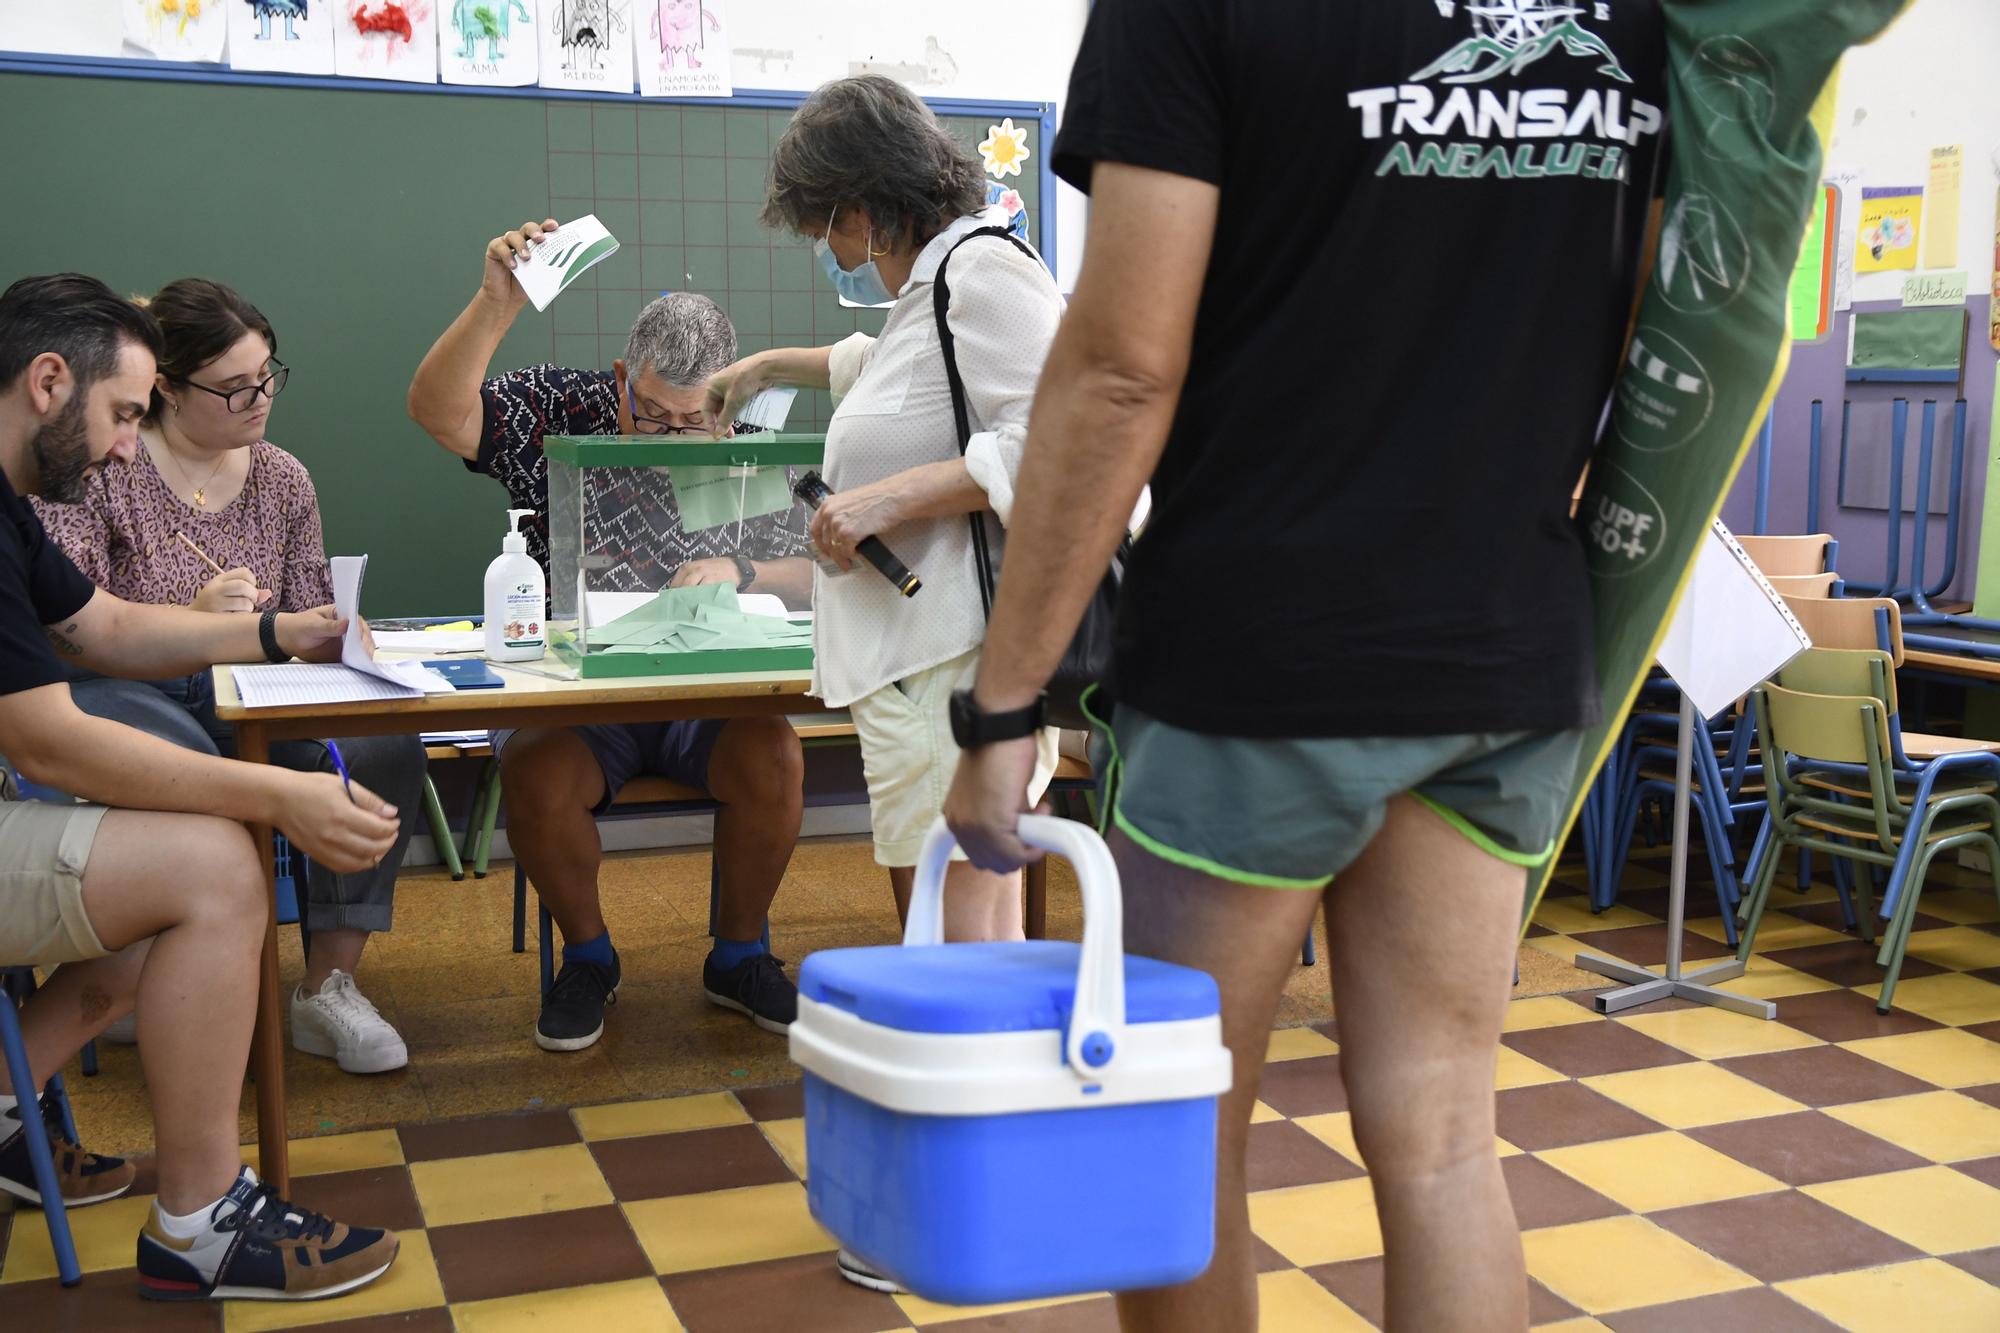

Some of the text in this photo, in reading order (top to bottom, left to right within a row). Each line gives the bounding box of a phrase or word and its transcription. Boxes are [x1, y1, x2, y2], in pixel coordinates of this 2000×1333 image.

[462, 63, 499, 75] CALMA
[563, 71, 605, 81] MIEDO
[658, 73, 720, 84] ENAMORADO
[659, 83, 721, 93] ENAMORADA
[1347, 84, 1662, 147] TRANSALP
[1904, 278, 1963, 303] Biblioteca
[1600, 495, 1654, 537] UPF
